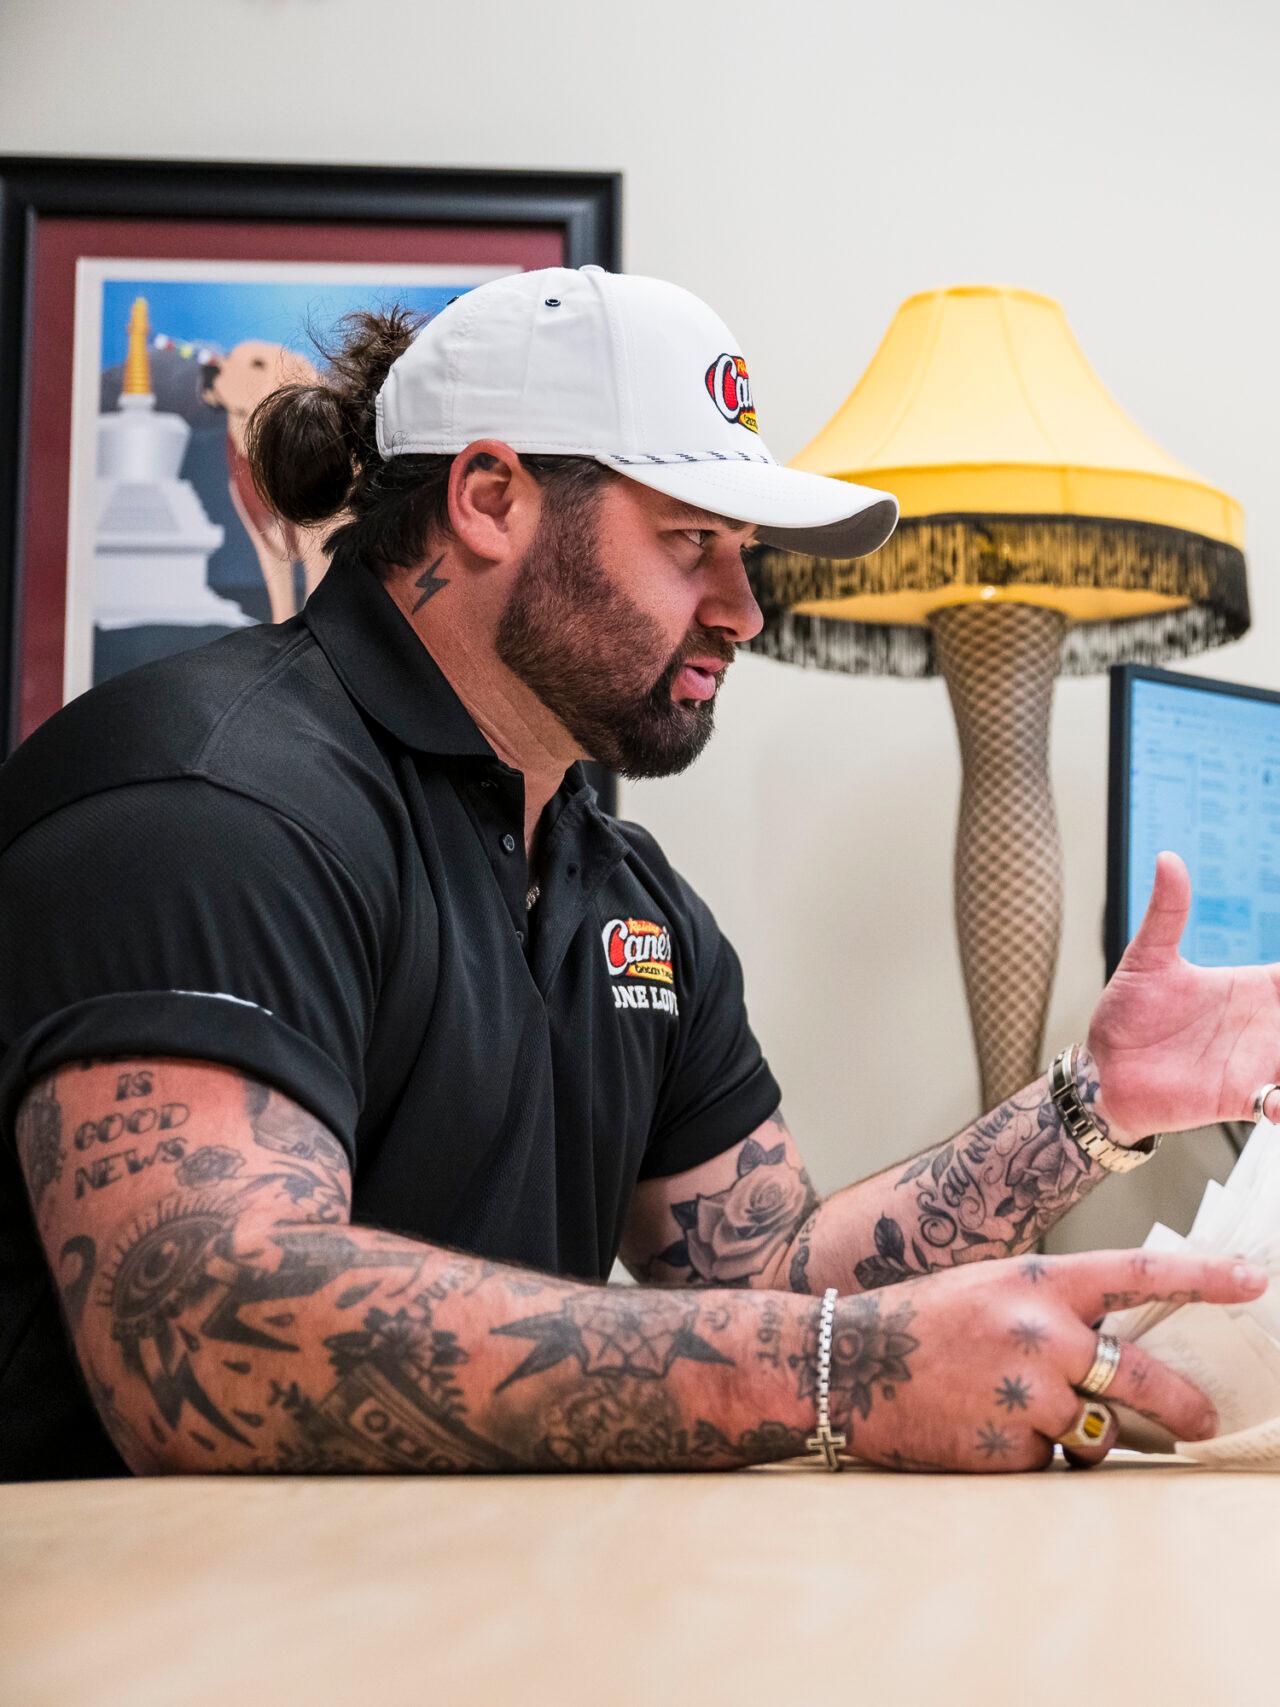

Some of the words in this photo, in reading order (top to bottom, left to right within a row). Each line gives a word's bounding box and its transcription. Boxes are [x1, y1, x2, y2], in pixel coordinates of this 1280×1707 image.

[650, 986, 679, 1016] LOV
[115, 1070, 154, 1102] IS
[73, 1102, 190, 1151] GOOD
[73, 1136, 189, 1200] NEWS
